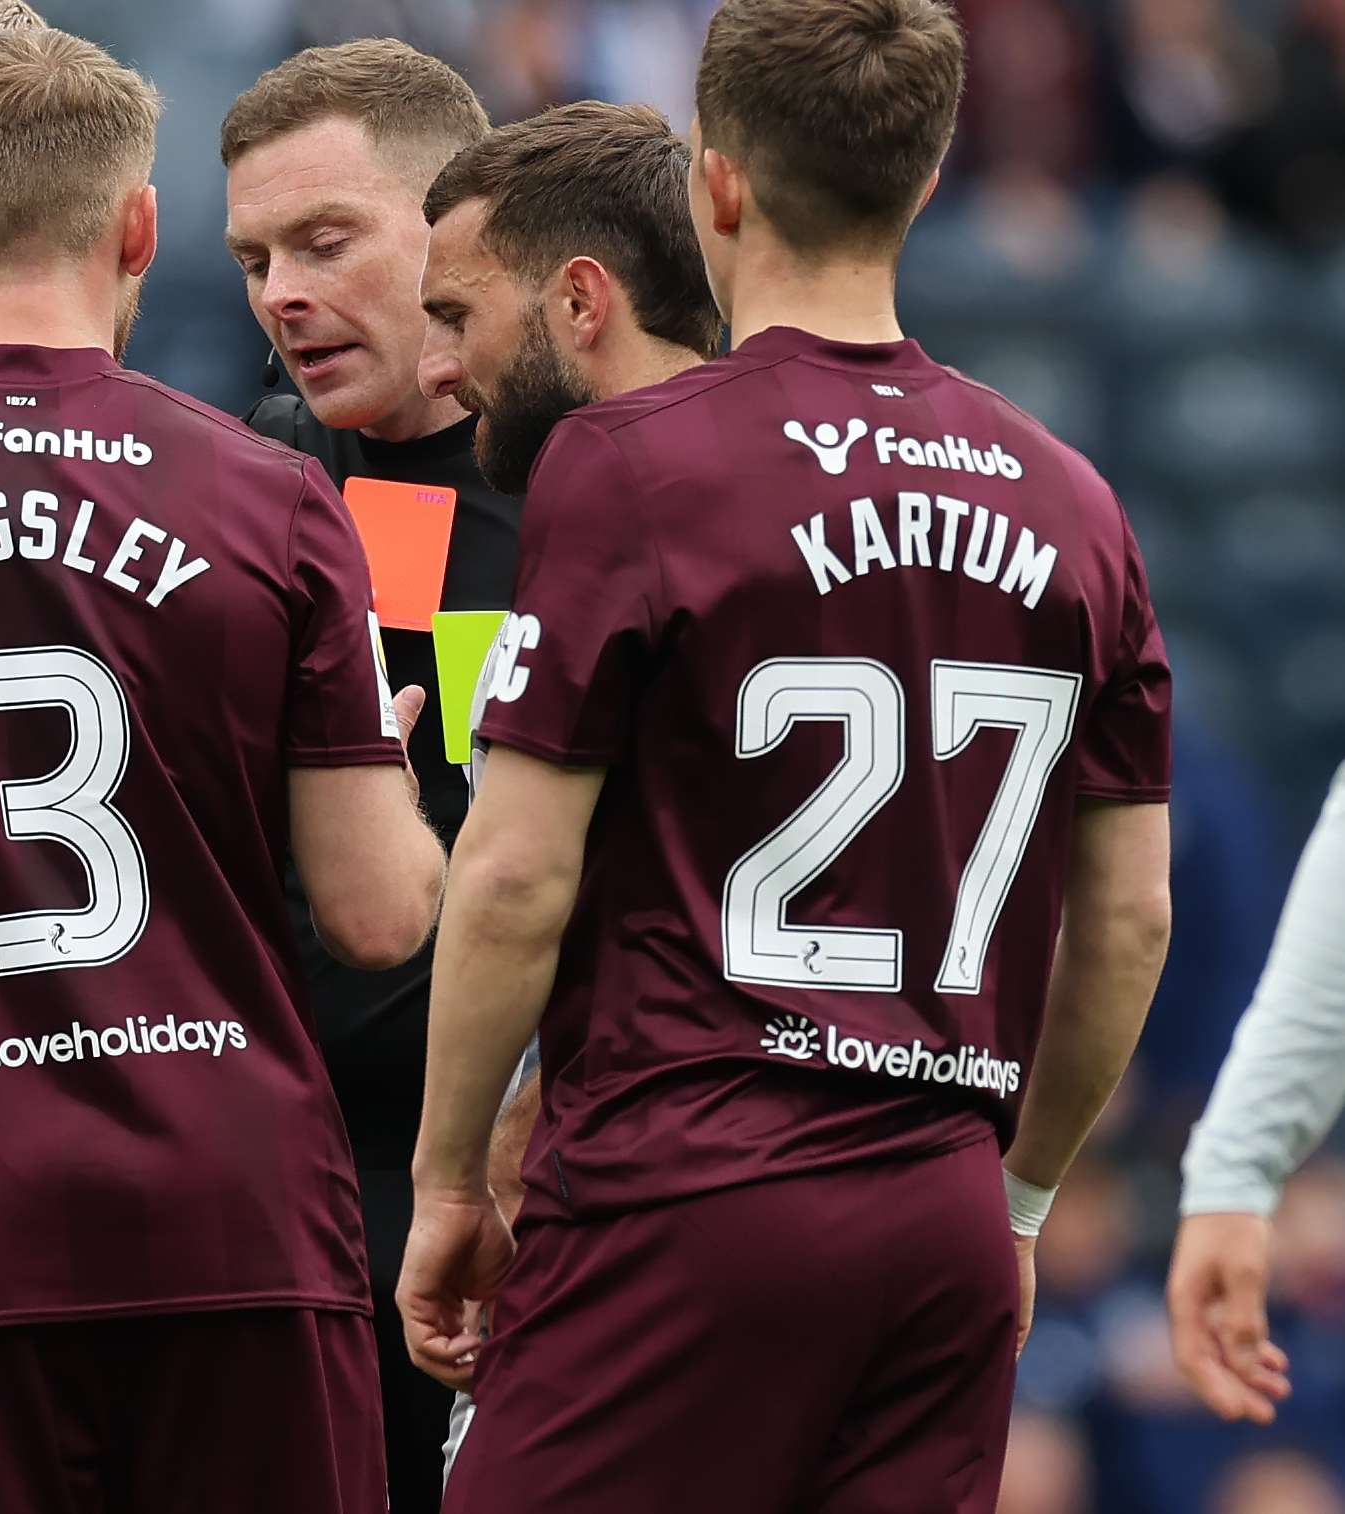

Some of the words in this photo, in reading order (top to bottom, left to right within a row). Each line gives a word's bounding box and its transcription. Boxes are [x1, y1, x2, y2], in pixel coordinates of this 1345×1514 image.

[5, 396, 37, 407] 1874
[874, 427, 1023, 480] FanHub
[790, 491, 1058, 611] KARTUM
[720, 656, 1084, 996] 27
[826, 1025, 1021, 1099] loveholidays
